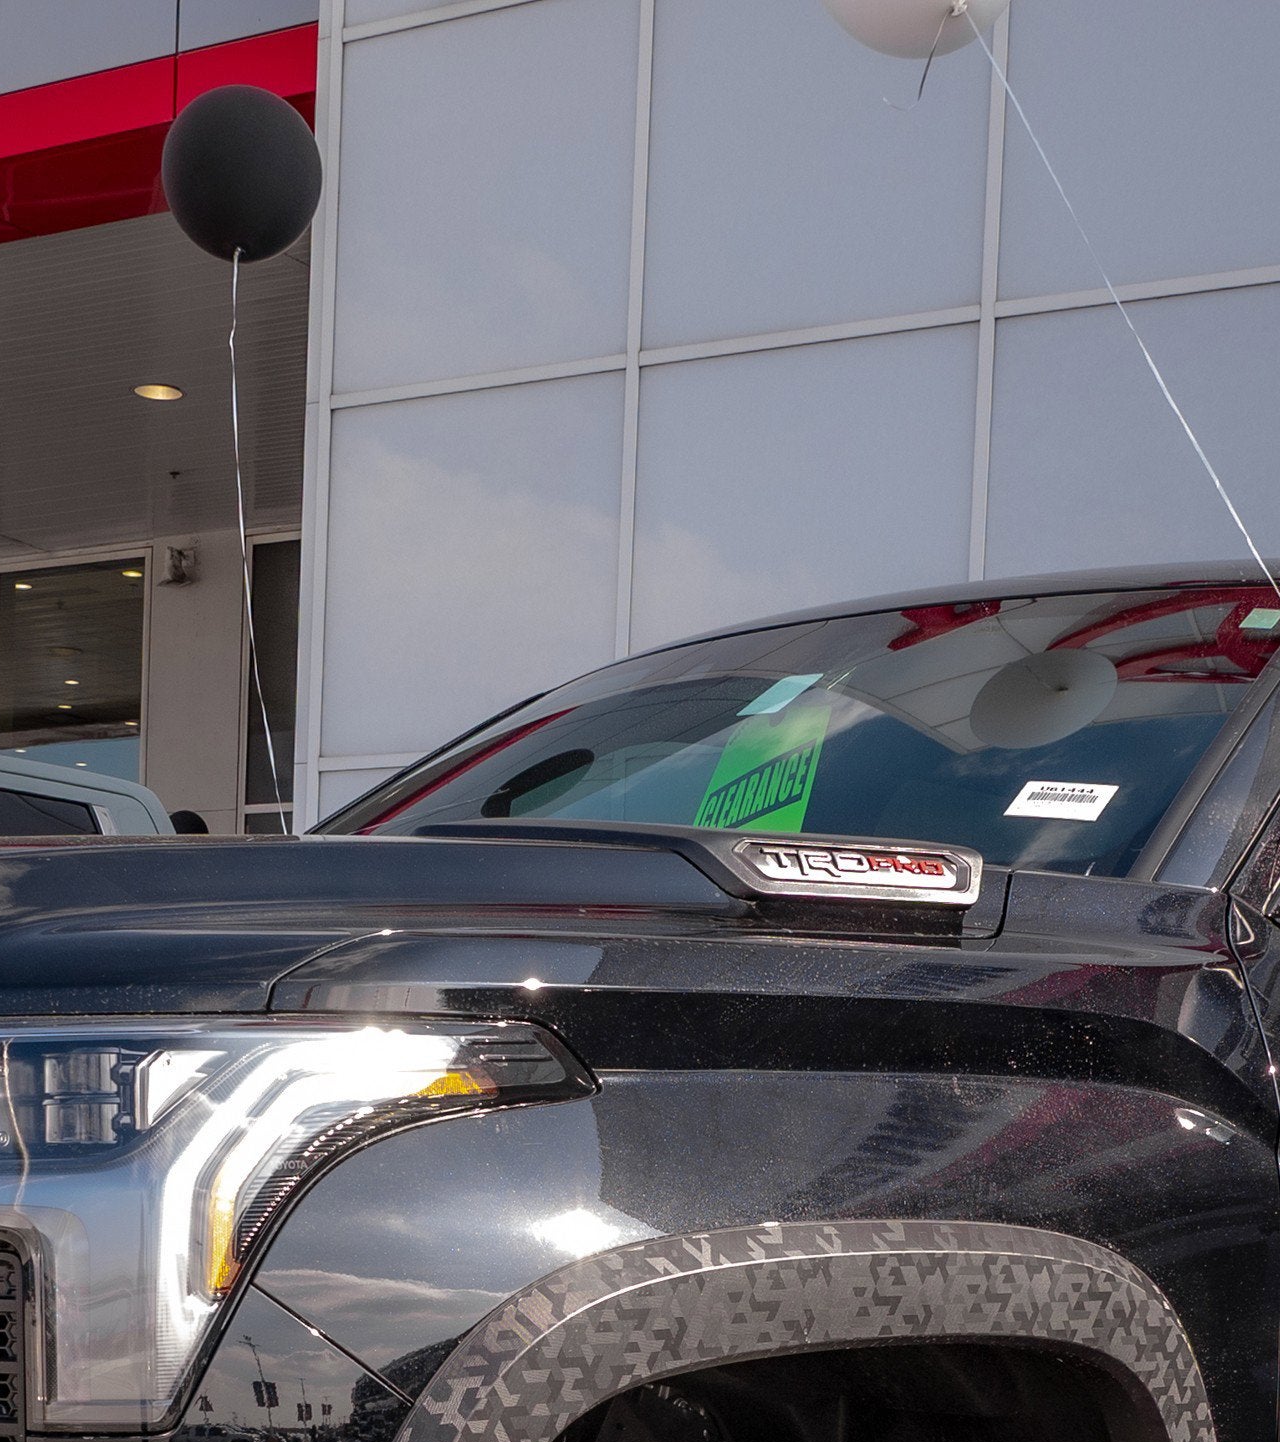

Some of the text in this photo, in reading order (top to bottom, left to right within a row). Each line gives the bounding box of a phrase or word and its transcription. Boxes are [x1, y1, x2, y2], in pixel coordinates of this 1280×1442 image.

[699, 747, 814, 829] CLEARANCE
[760, 847, 946, 878] TRD PRO
[273, 1160, 308, 1170] OYOTA
